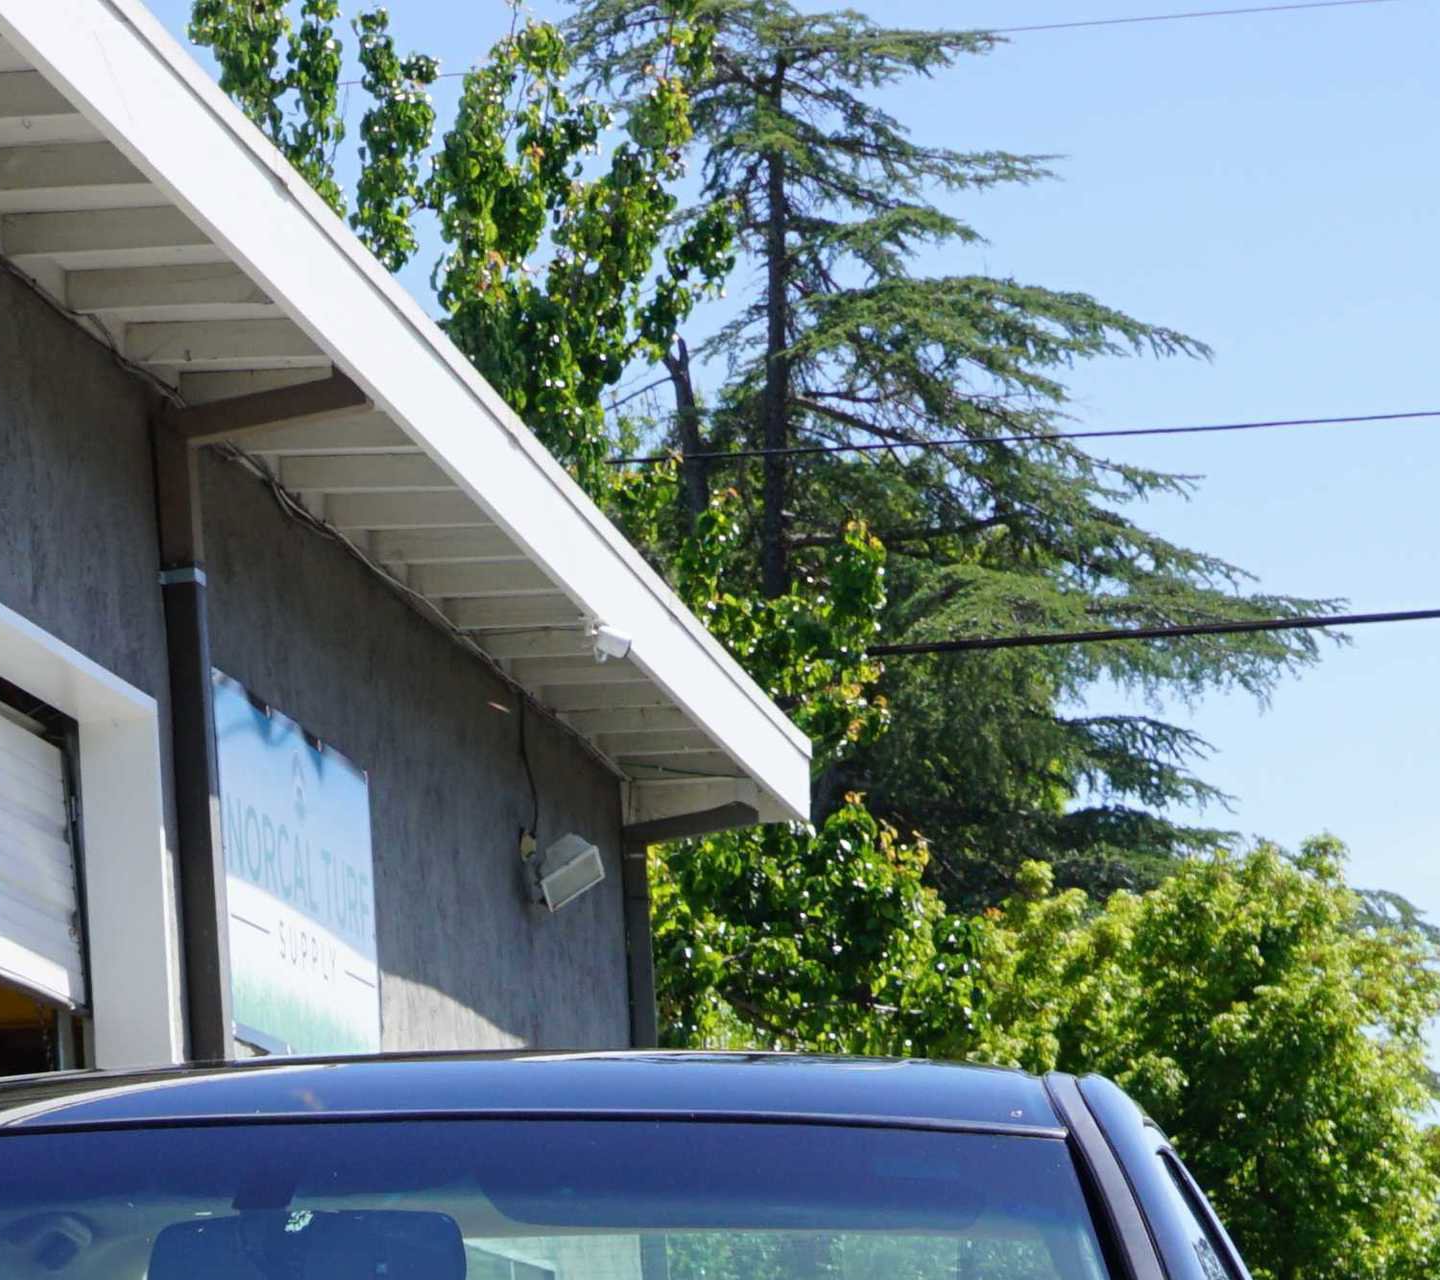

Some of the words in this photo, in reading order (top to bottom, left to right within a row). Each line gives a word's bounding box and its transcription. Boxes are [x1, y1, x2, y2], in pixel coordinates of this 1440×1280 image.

[227, 794, 319, 916] NORCAL
[320, 848, 370, 945] TURF
[276, 918, 337, 983] SUPPLY
